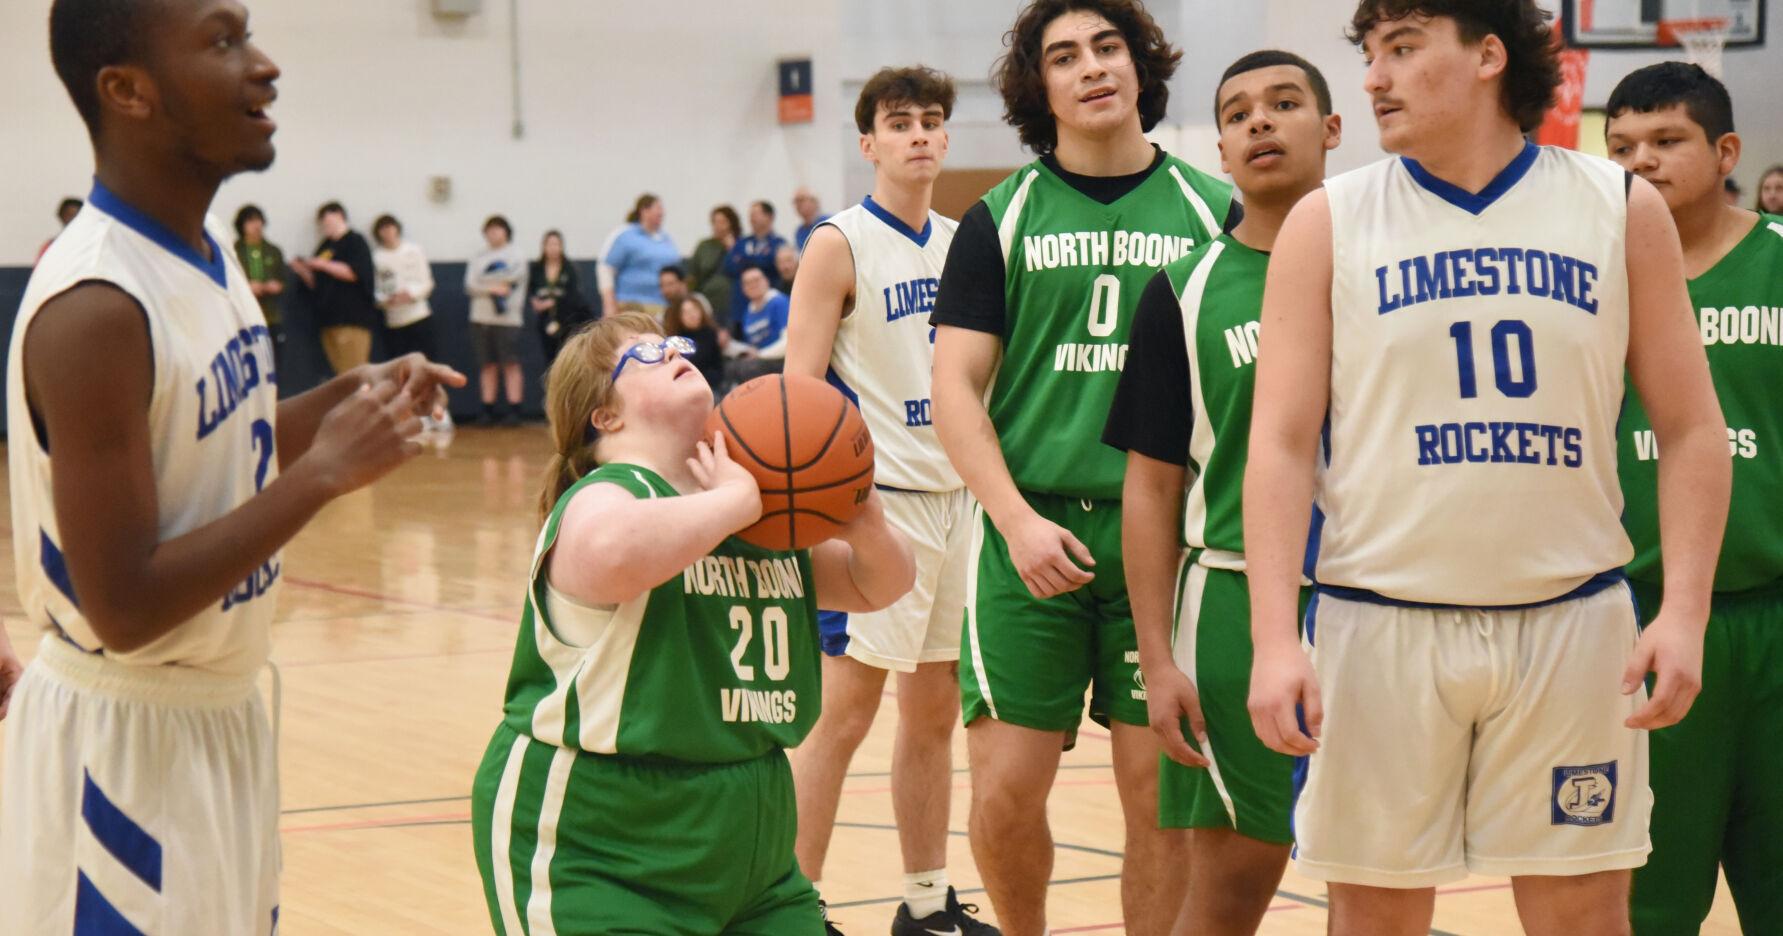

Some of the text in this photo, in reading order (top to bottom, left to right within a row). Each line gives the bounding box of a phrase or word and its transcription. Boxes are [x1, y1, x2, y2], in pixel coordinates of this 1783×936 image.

[1024, 231, 1109, 272] NORTH
[883, 277, 941, 322] LIMES
[1375, 247, 1599, 316] LIMESTONE
[1087, 273, 1120, 337] 0
[1700, 305, 1783, 346] BOON
[1224, 320, 1260, 368] NO
[1449, 319, 1538, 400] 10
[904, 399, 932, 427] RO
[1415, 421, 1583, 468] ROCKETS
[683, 555, 805, 599] NORTH BOON
[728, 605, 790, 682] 20
[1124, 650, 1140, 664] NOR
